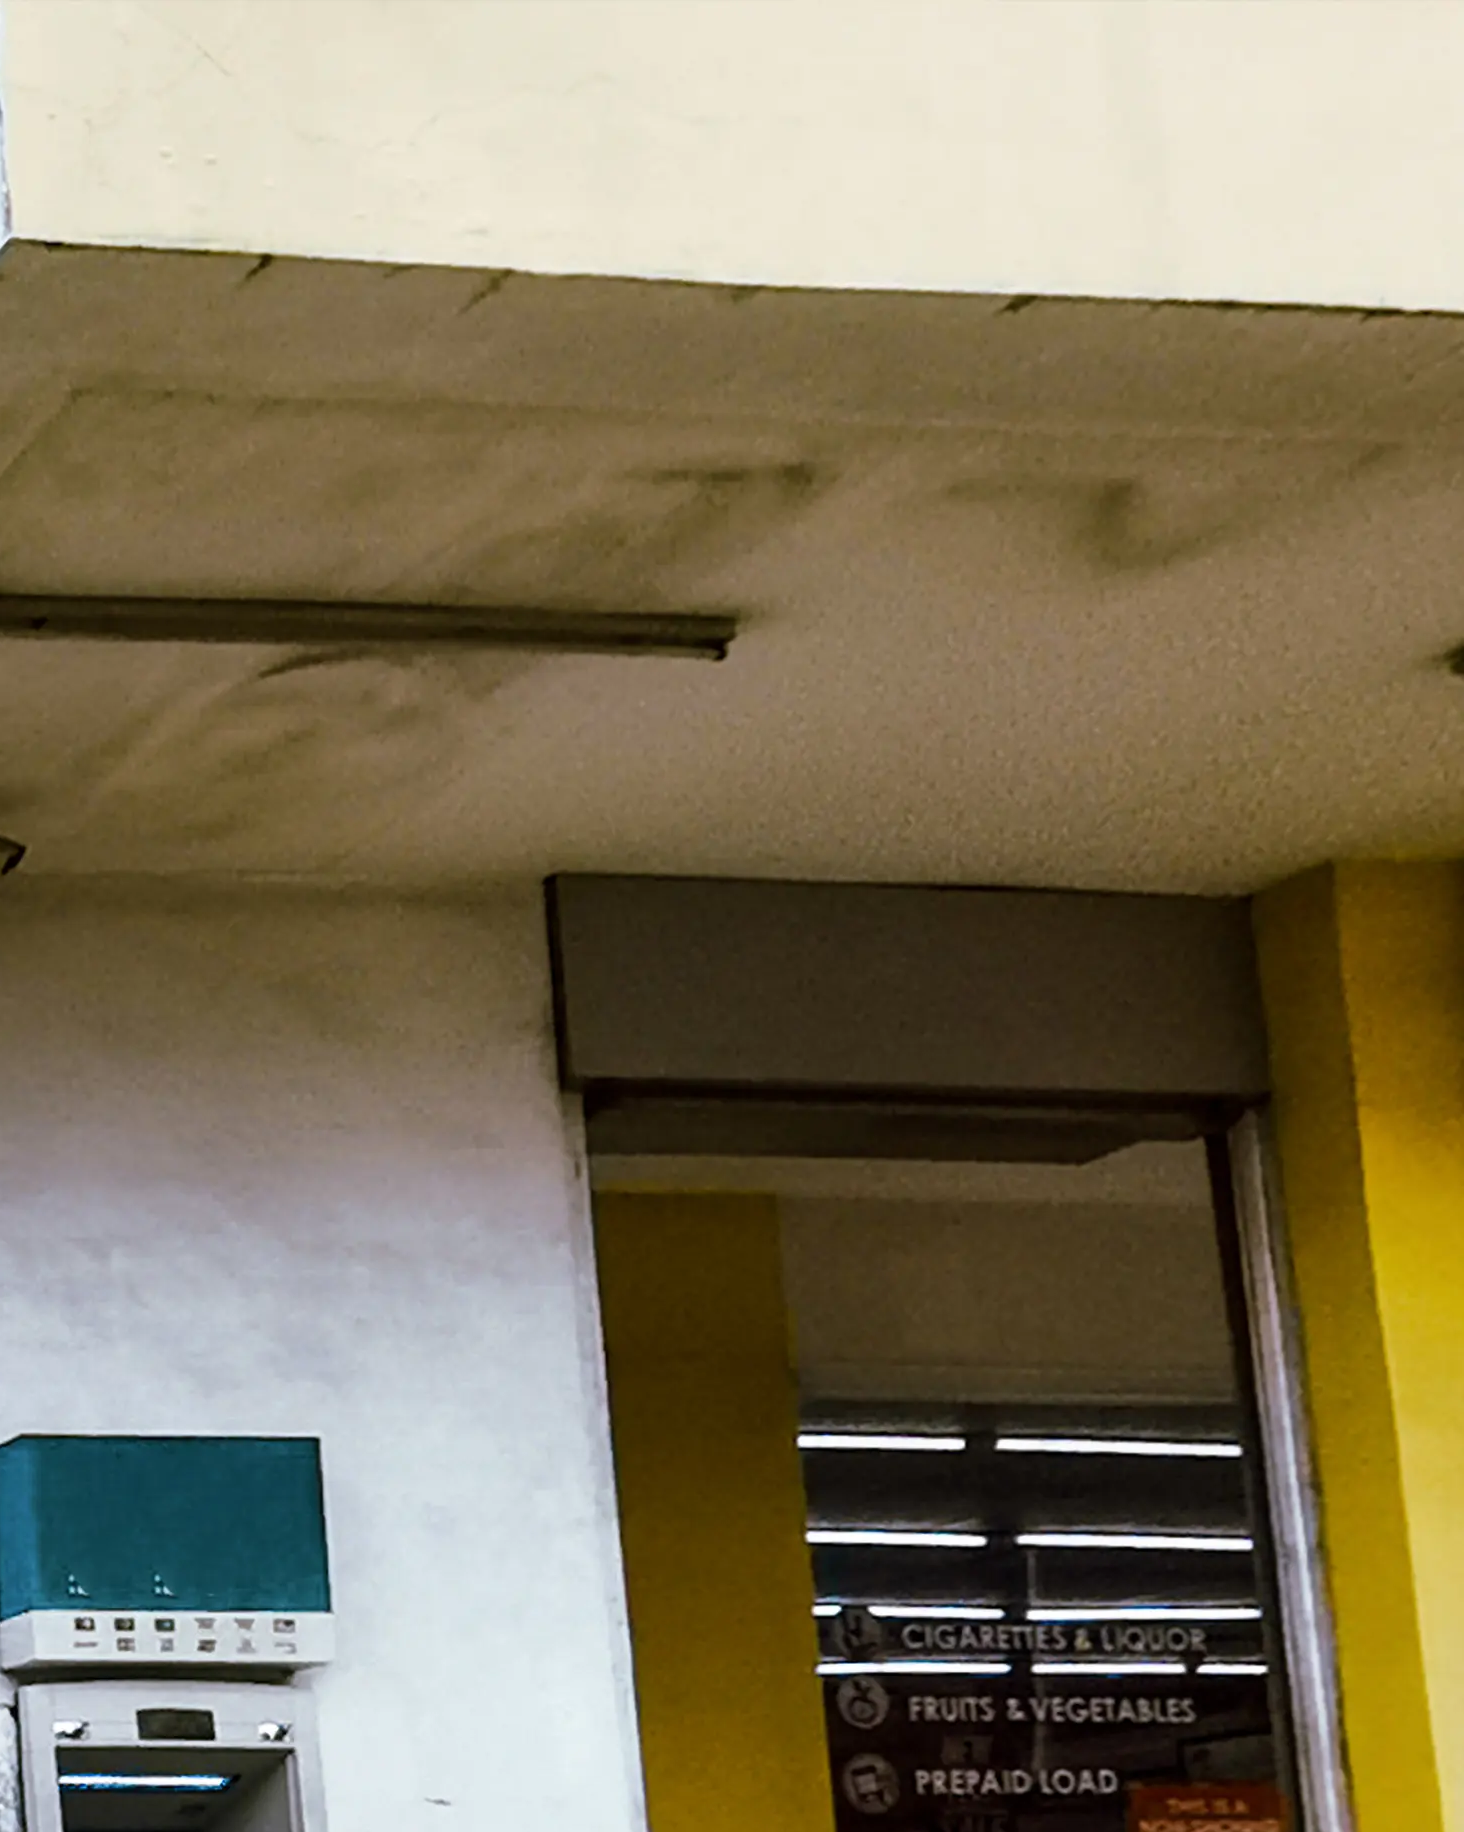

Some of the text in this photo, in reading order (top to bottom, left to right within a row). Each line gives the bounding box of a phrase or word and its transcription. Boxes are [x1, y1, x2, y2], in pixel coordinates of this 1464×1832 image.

[901, 1623, 1067, 1651] CIGARETTES
[1101, 1626, 1208, 1653] LIQUOR
[909, 1697, 1197, 1724] FRUITS & VEGETABLES
[915, 1768, 1119, 1795] PREPAID LOAD
